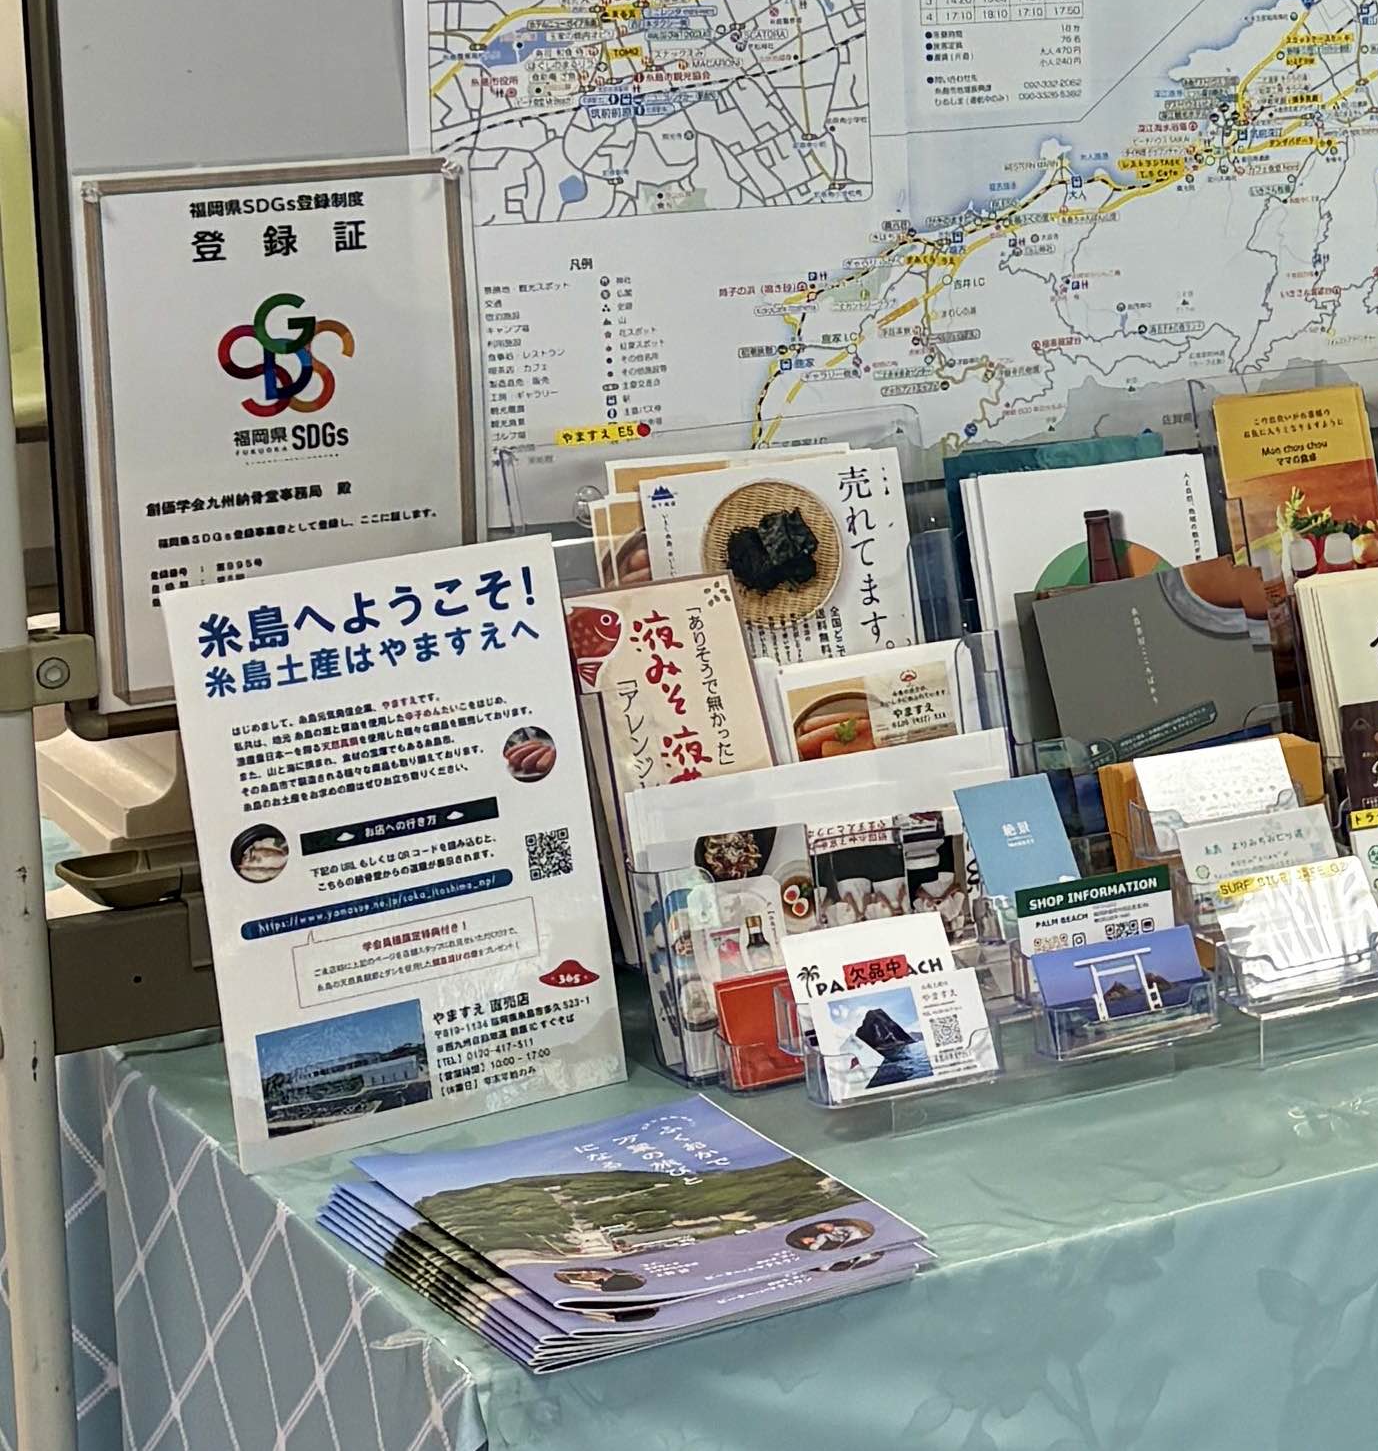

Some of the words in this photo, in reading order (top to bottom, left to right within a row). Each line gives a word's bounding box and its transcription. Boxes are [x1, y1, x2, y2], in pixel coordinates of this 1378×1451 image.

[189, 191, 365, 219] 福岡県SDGs登録制度
[568, 256, 594, 271] 凡例
[233, 427, 288, 448] 福岡県
[291, 422, 350, 450] SDGs
[561, 428, 611, 443] やますえ
[197, 565, 538, 659] 糸島へようこそ！
[204, 620, 540, 699] 糸島土産はやますえへ
[1028, 893, 1066, 911] SHOP
[1067, 877, 1158, 905] INFORMATION
[1034, 916, 1059, 929] PALM
[1060, 912, 1089, 925] BEACH
[849, 959, 907, 981] 欠品中
[432, 1001, 485, 1025] やますえ
